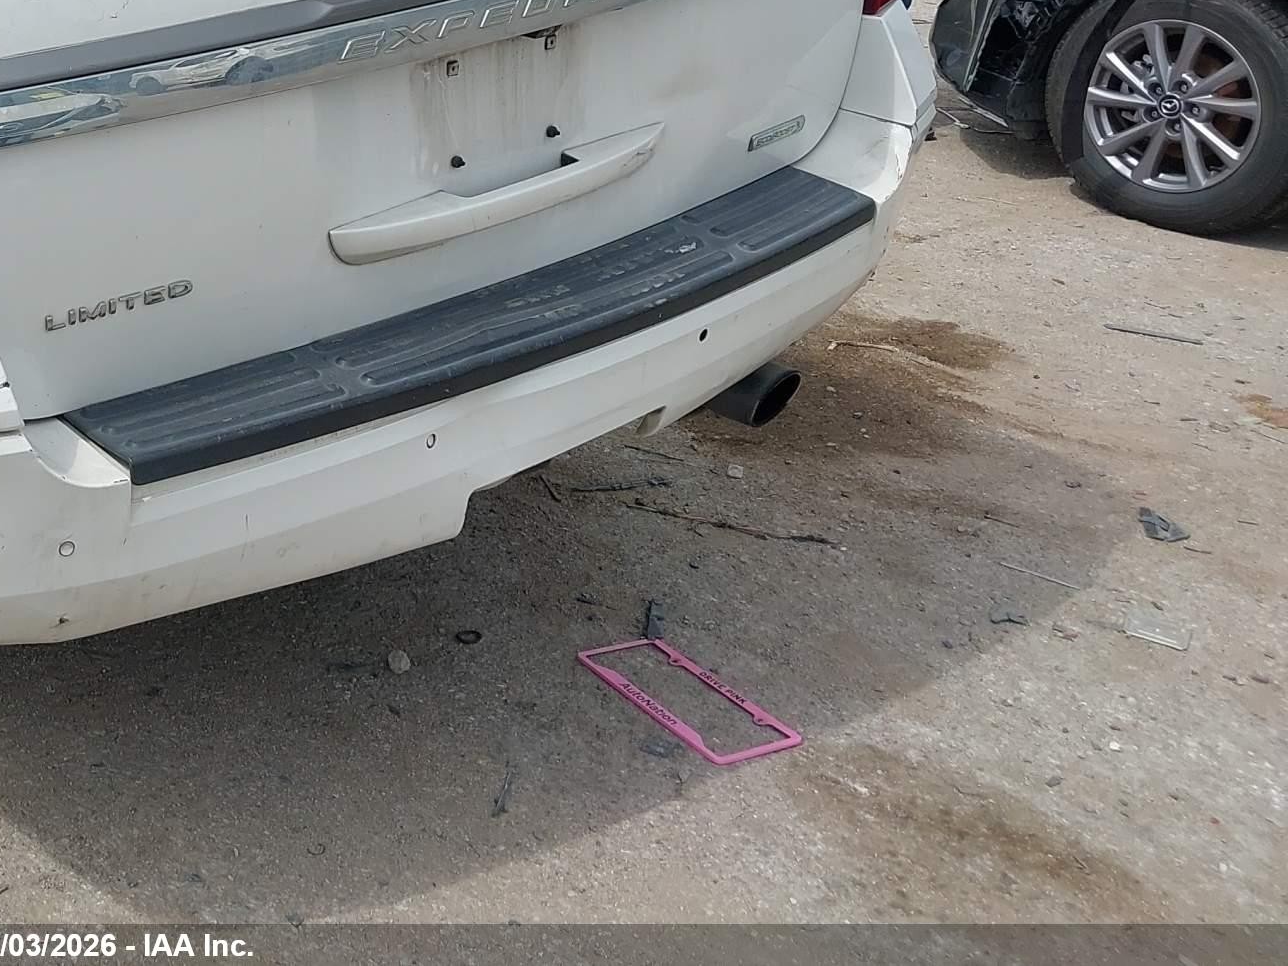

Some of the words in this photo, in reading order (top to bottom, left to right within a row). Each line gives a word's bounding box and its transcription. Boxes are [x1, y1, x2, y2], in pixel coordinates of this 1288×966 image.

[44, 279, 194, 332] LIMITED
[619, 682, 678, 725] AutoNation
[699, 671, 727, 690] DRIVE
[725, 689, 747, 704] PINK
